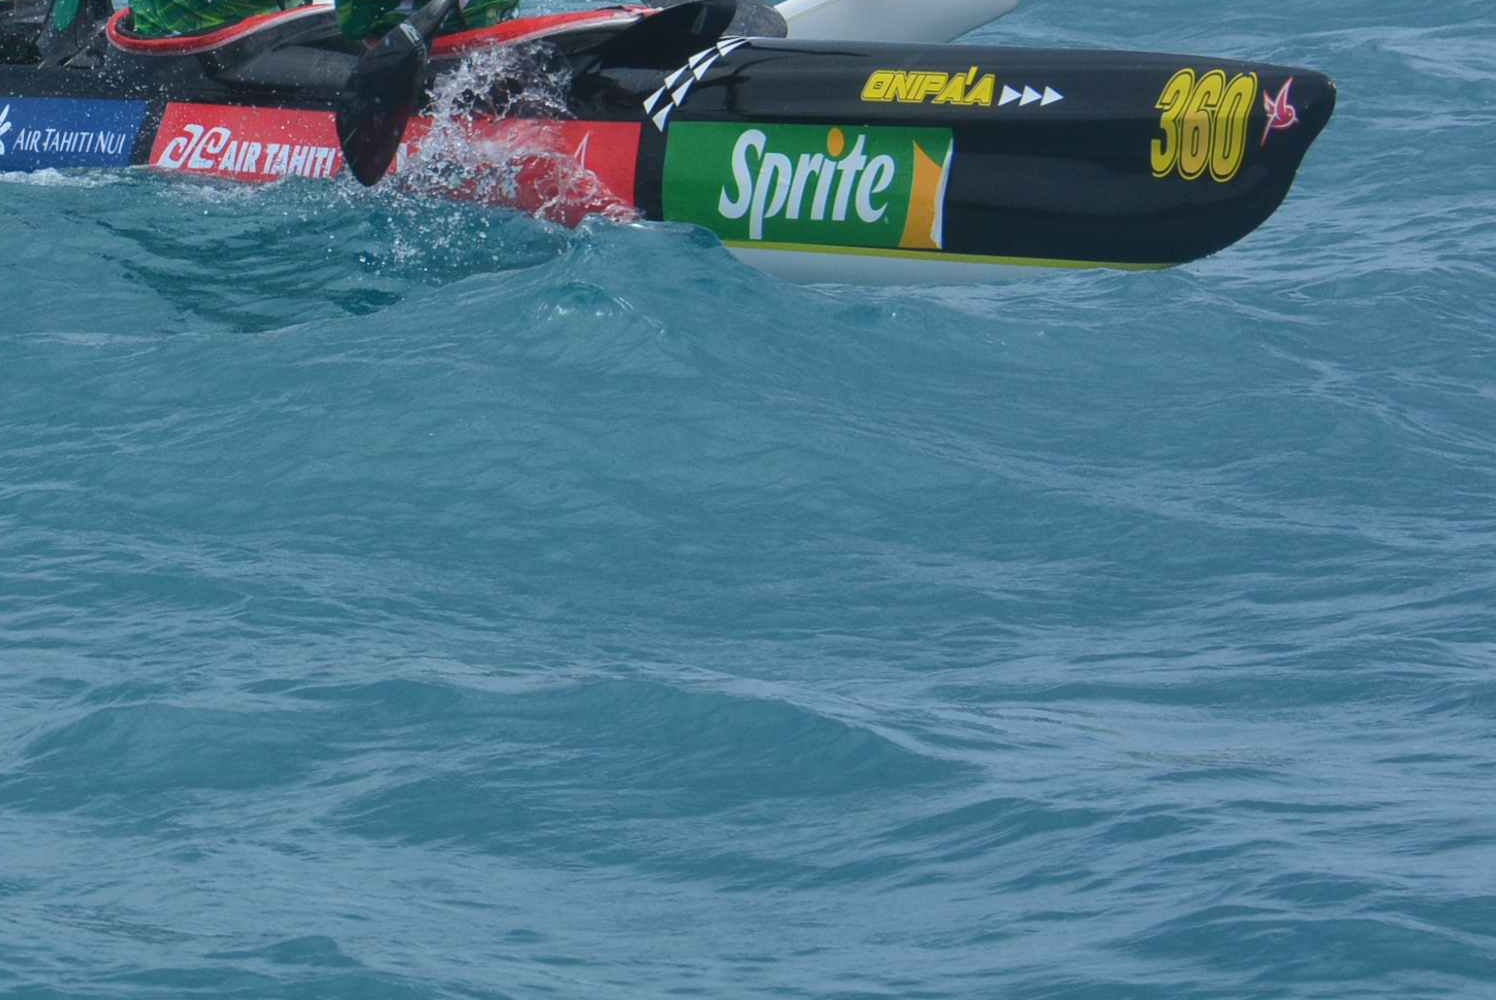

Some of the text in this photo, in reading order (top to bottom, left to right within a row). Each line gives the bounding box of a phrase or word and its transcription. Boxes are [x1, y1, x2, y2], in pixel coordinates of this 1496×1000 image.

[12, 128, 126, 154] AIR TAHITI NUI
[218, 140, 337, 178] AIR TAHITI
[1151, 68, 1258, 182] 360
[718, 128, 896, 239] Sprite
